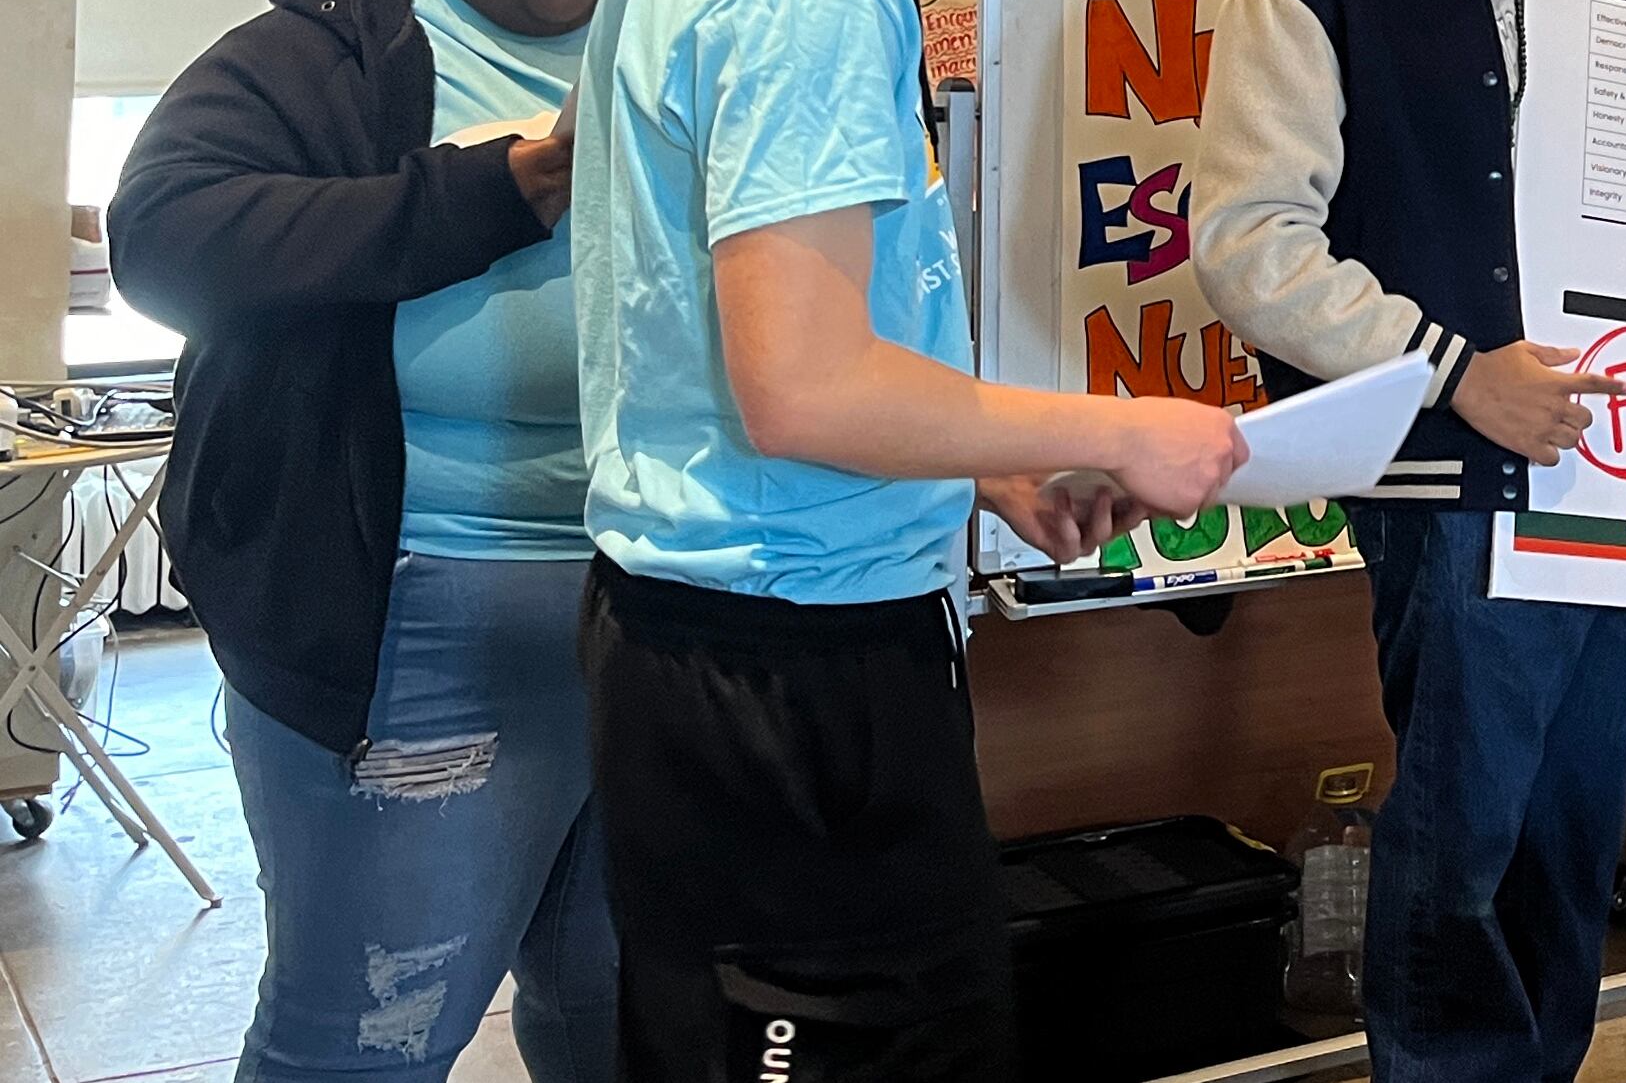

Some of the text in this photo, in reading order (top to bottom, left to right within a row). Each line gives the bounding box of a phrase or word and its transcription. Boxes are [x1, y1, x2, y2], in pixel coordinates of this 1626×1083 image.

[1593, 86, 1619, 101] Safety
[1592, 110, 1625, 125] Honesty
[1591, 162, 1626, 178] Visionary
[1589, 187, 1623, 203] Integrity
